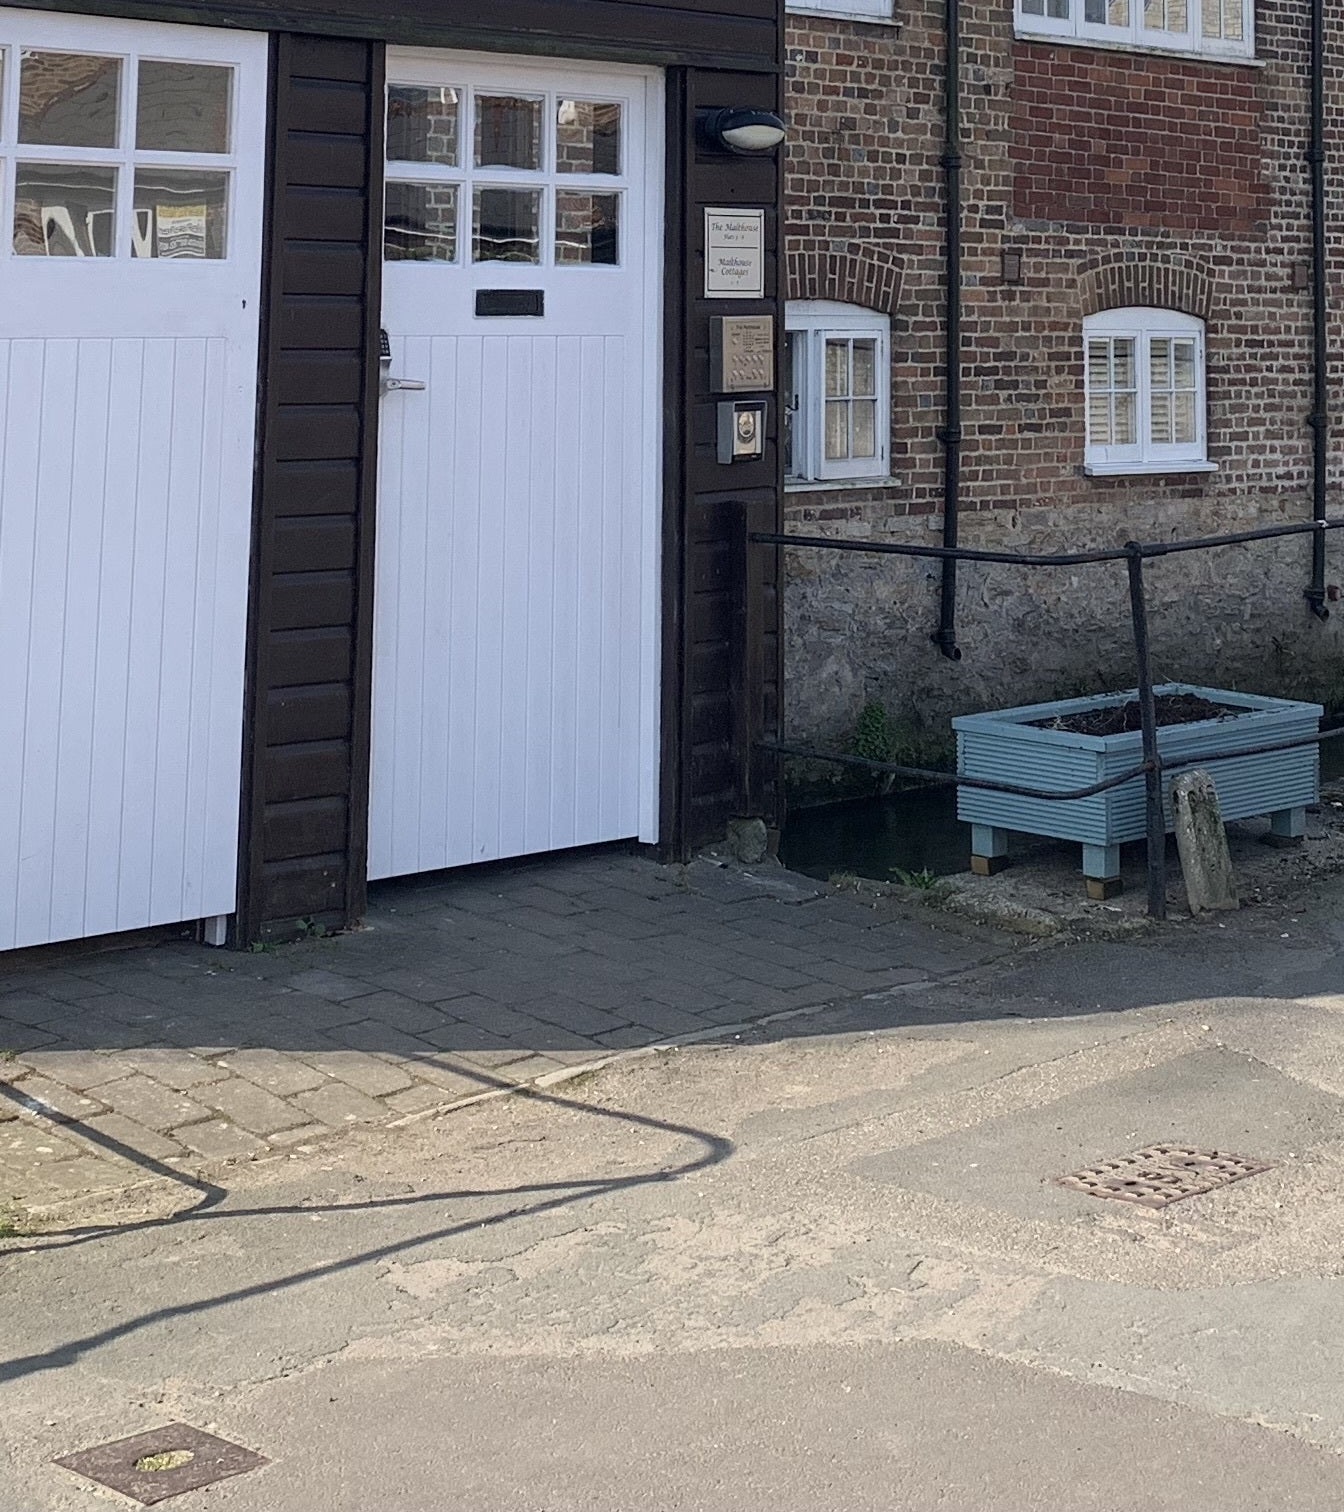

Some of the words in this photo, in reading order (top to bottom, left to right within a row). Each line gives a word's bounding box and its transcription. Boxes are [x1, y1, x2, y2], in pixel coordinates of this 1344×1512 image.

[712, 222, 723, 231] The
[724, 223, 759, 232] Malthouse
[717, 257, 753, 267] Malthouse
[721, 268, 749, 279] Cottages
